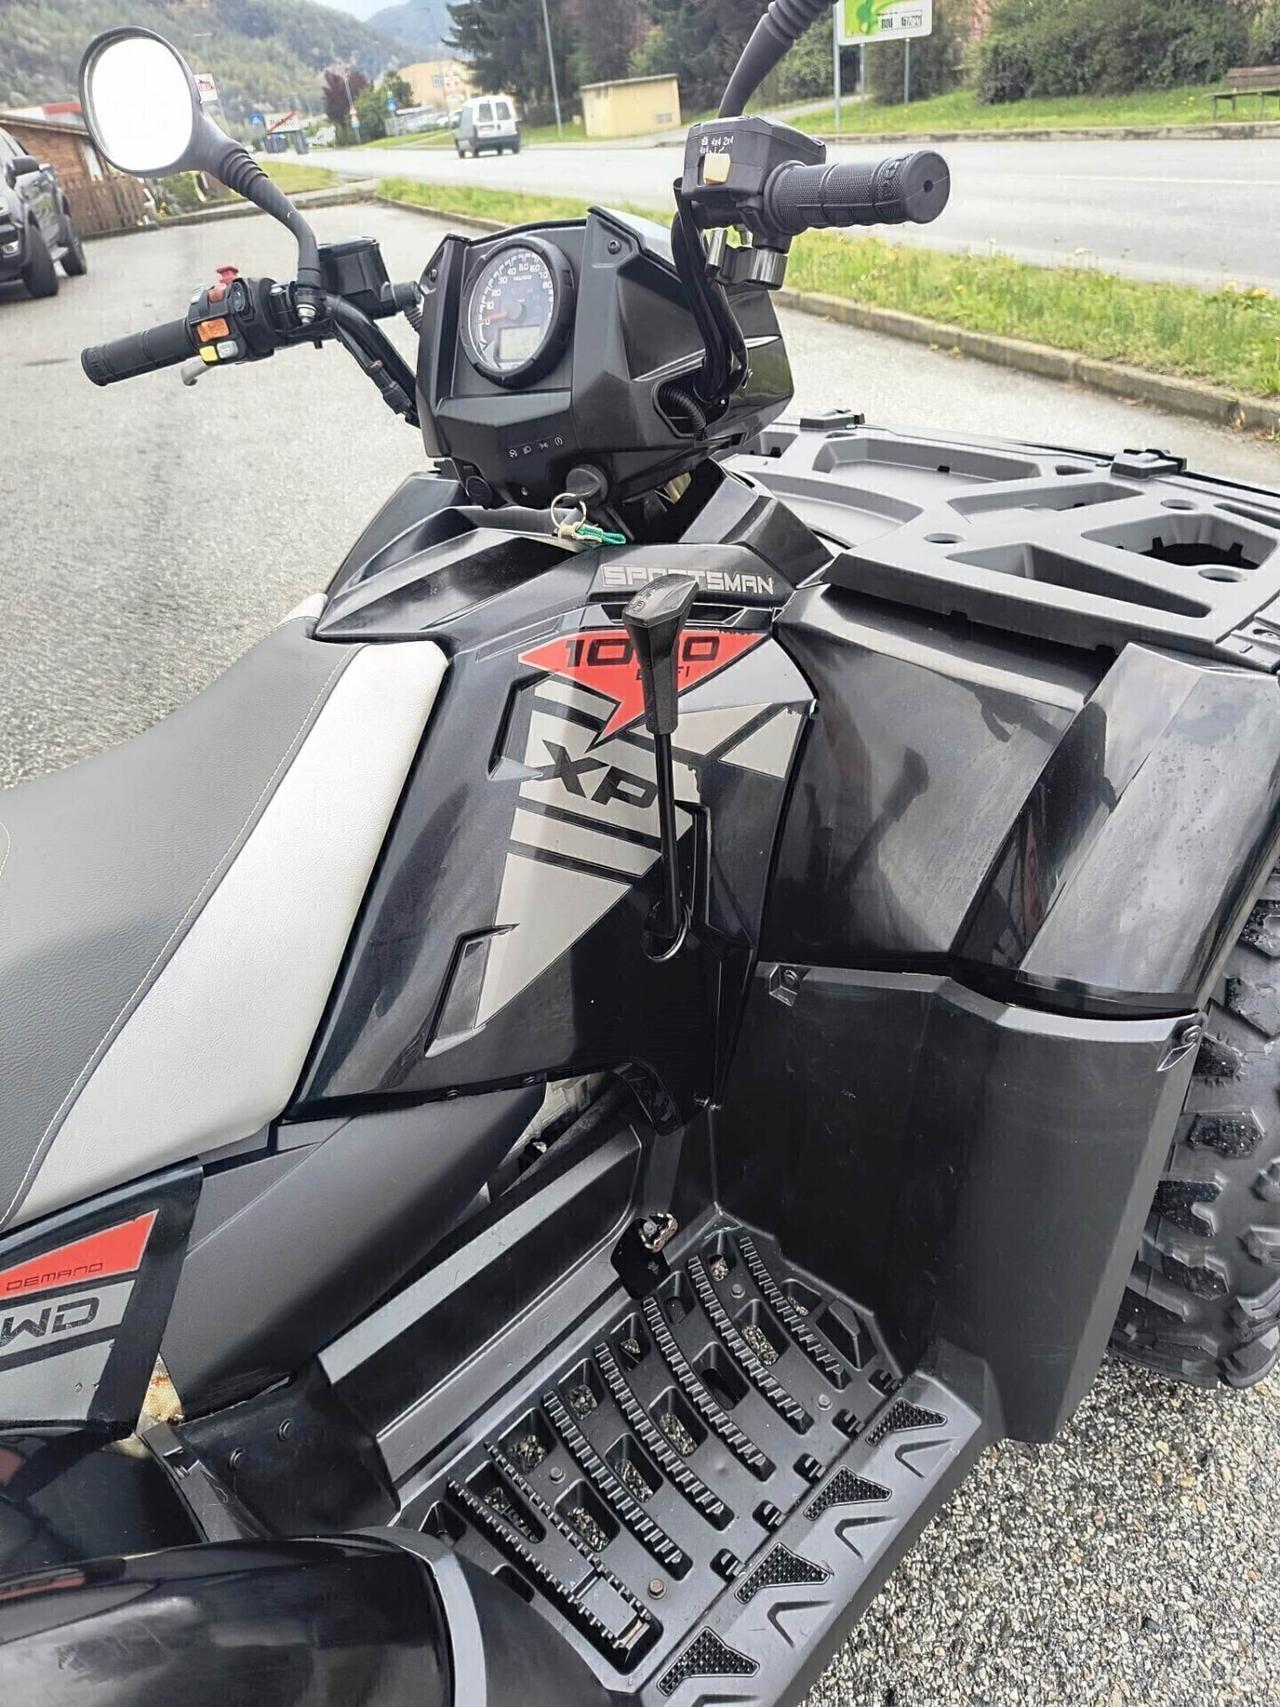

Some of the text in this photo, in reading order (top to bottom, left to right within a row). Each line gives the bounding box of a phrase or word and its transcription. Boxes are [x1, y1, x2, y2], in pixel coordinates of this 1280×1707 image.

[566, 636, 720, 668] 100
[540, 739, 658, 809] XP
[6, 1262, 104, 1291] DEMAND
